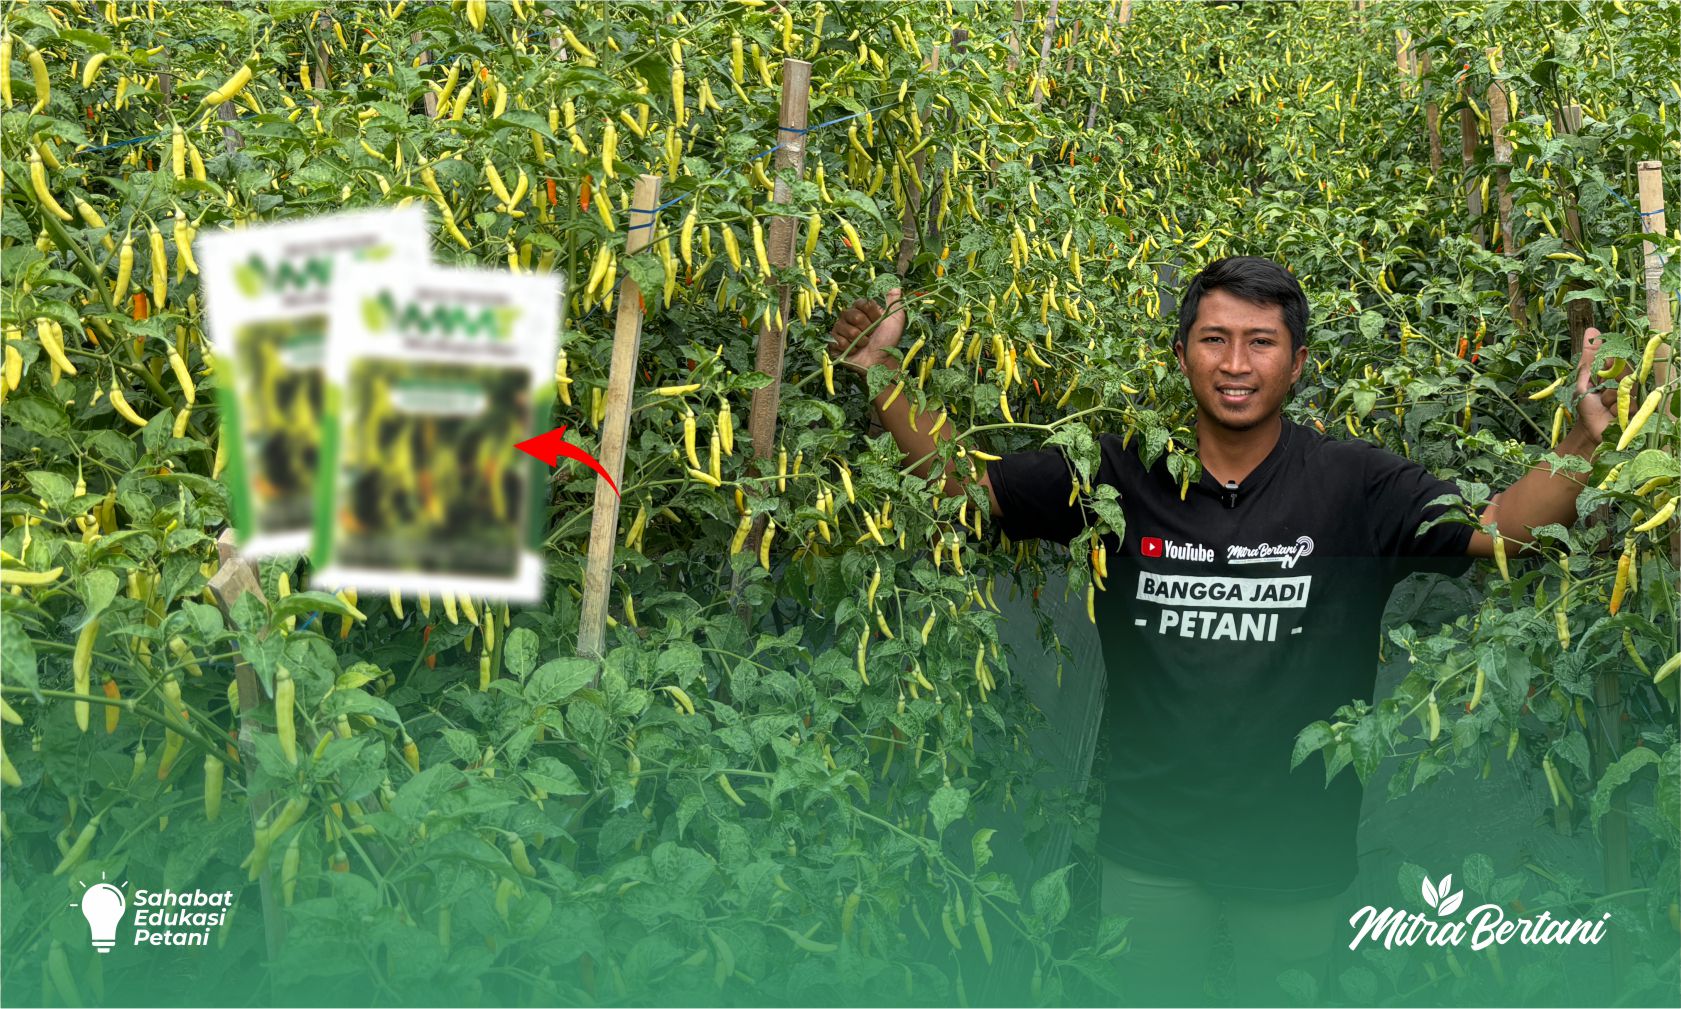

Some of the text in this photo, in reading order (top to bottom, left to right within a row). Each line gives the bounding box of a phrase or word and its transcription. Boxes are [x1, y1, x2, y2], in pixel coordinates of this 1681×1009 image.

[1164, 540, 1215, 562] YouTube
[1227, 543, 1299, 559] Mitra Bertani
[1143, 577, 1306, 602] BANGGA JADI
[1158, 609, 1279, 642] PETANI
